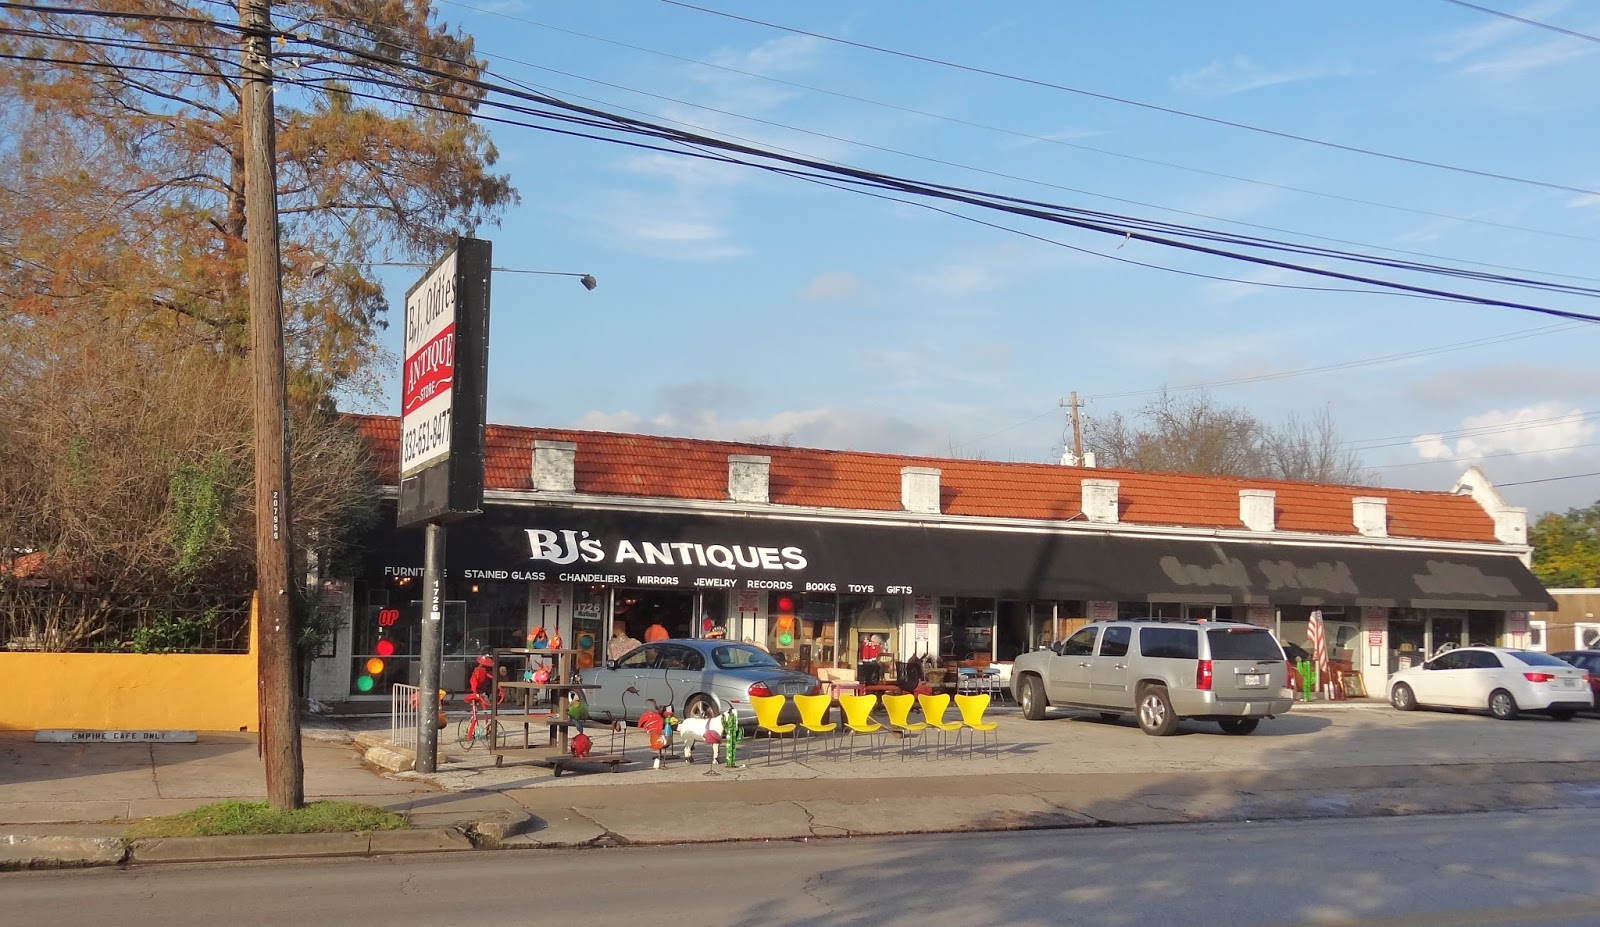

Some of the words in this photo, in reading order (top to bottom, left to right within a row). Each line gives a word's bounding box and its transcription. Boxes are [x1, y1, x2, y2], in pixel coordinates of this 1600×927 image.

[409, 298, 423, 342] B.J.
[426, 273, 457, 325] Oldies
[407, 333, 453, 394] ANTIQUE
[420, 380, 436, 401] STORE
[404, 408, 451, 462] 832-651-8477
[524, 528, 605, 564] BJ's
[615, 539, 808, 570] ANTIQUES
[384, 566, 448, 577] FURNITE
[464, 569, 508, 579] STAINED
[511, 571, 546, 581] GLASS
[559, 573, 626, 584] CHANDELIERS
[637, 575, 679, 586] MIRRORS
[694, 577, 737, 588] JEWELRY
[747, 580, 793, 590] RECORDS
[806, 583, 837, 592] BOOKS
[848, 584, 874, 593] TOYS
[886, 586, 912, 595] GIFTS
[432, 580, 440, 611] 1726
[577, 602, 601, 613] 1726
[71, 732, 107, 740] EMPIRE
[113, 732, 137, 740] CAFE
[143, 732, 167, 740] ONLY
